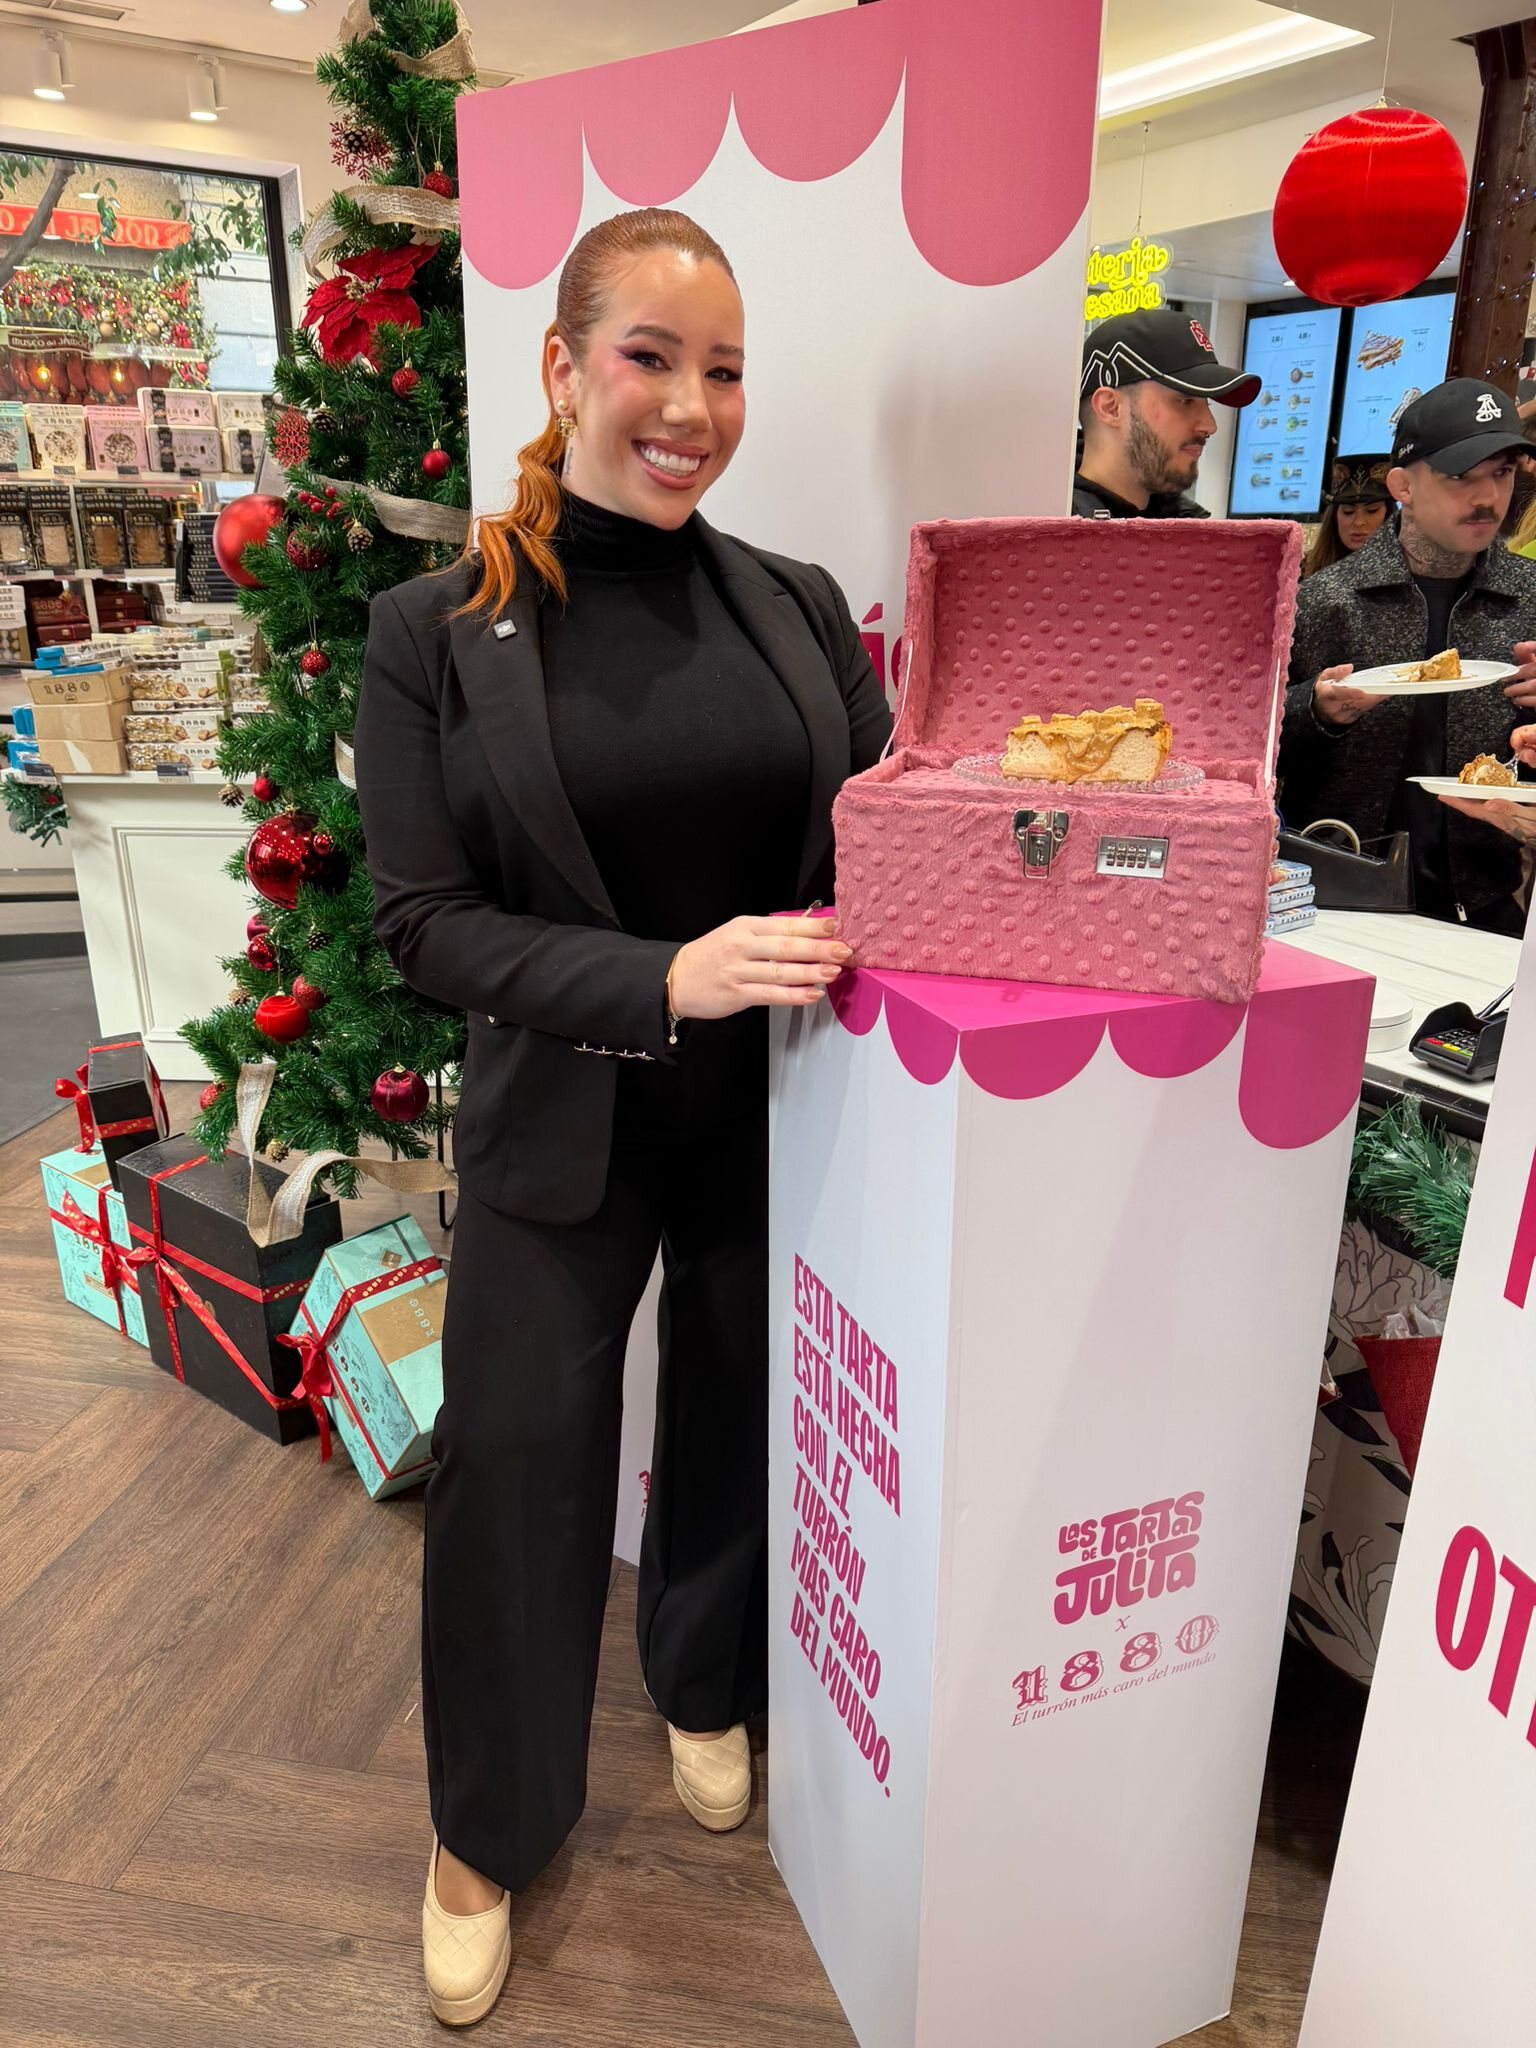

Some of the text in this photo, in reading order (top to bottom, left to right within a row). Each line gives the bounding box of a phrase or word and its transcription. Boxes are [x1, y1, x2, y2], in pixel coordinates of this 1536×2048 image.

[43, 680, 91, 695] 1880
[793, 1252, 898, 1434] ESTA TARTA
[793, 1322, 901, 1518] ESTÁ HECHA
[793, 1394, 853, 1521] CON EL
[793, 1461, 867, 1607] TURRÓN
[790, 1527, 882, 1700] MÁS CARO
[1081, 1547, 1098, 1562] DE
[789, 1591, 891, 1799] DEL MUNDO.
[1011, 1651, 1217, 1727] El turrón más caro del mundo
[1436, 1525, 1536, 1750] OT
